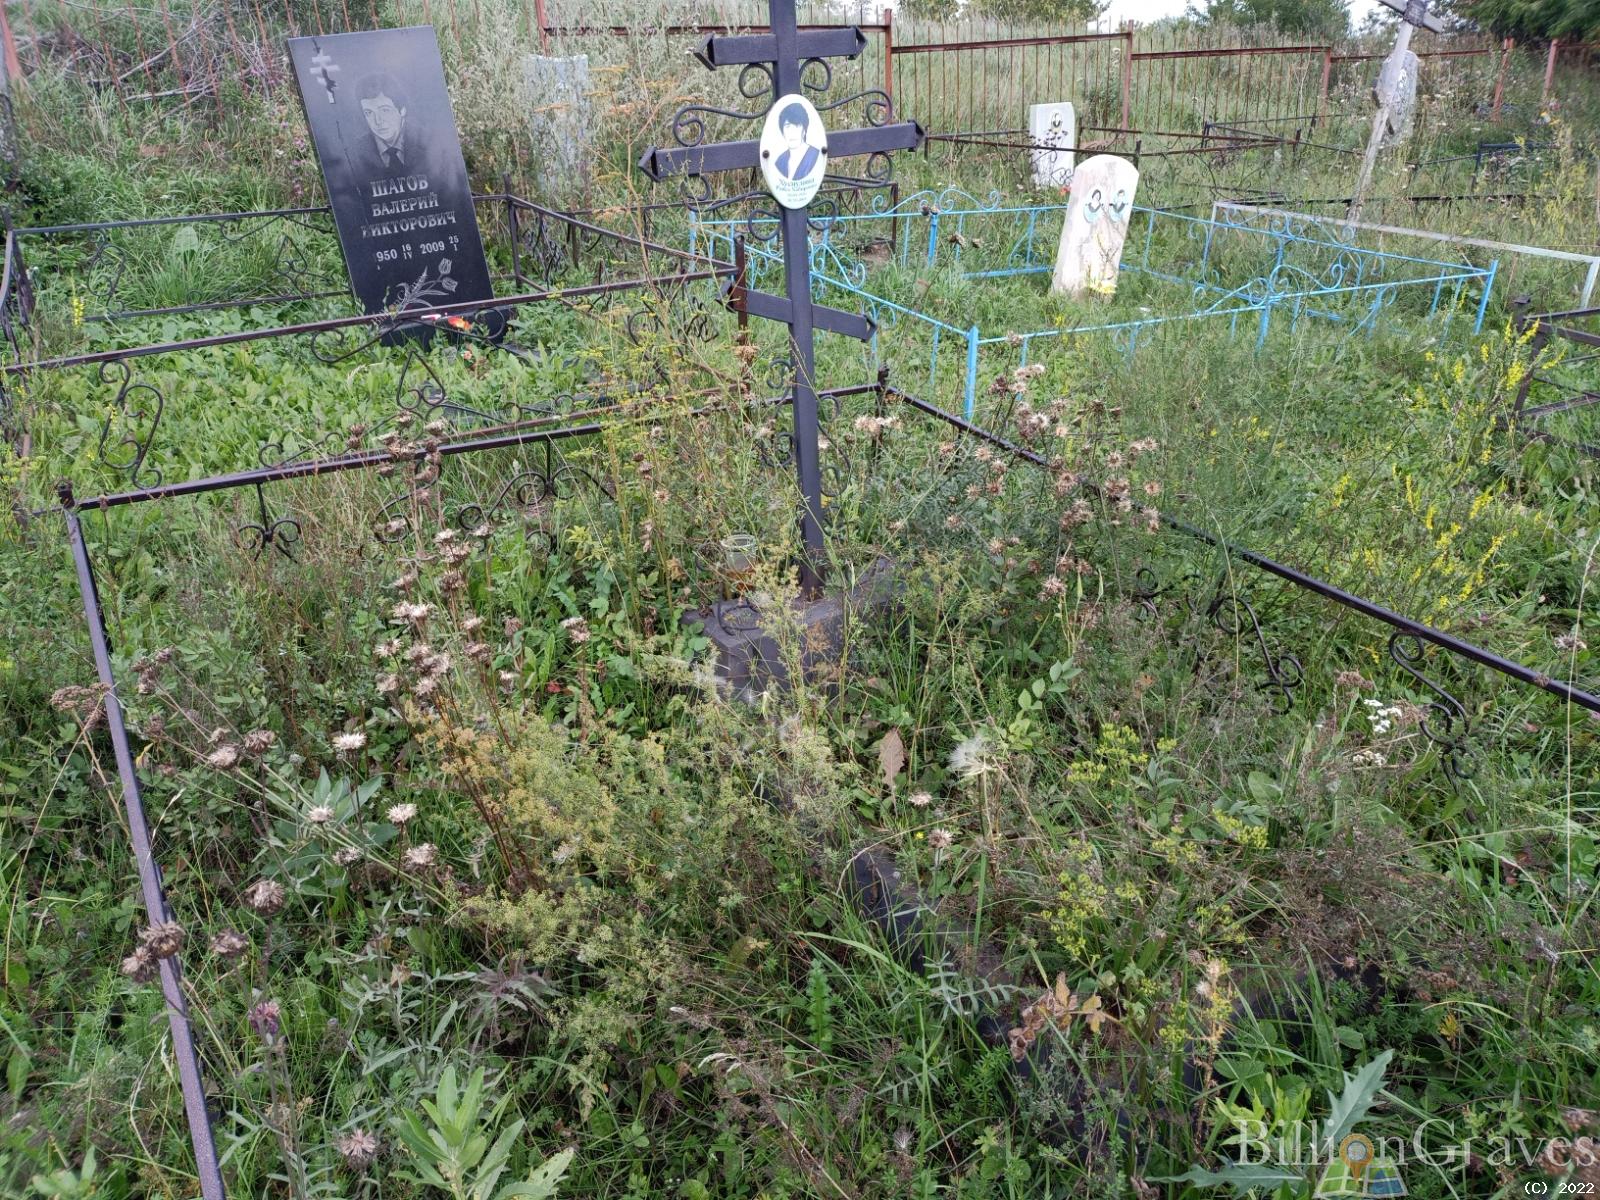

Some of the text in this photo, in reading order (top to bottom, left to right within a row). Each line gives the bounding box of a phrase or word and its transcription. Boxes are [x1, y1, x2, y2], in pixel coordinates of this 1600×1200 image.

[369, 173, 429, 197] ШАГОВ
[371, 191, 439, 217] ВАЛЕРИЙ
[373, 248, 398, 262] 950
[419, 240, 445, 254] 2009
[448, 235, 459, 244] 25
